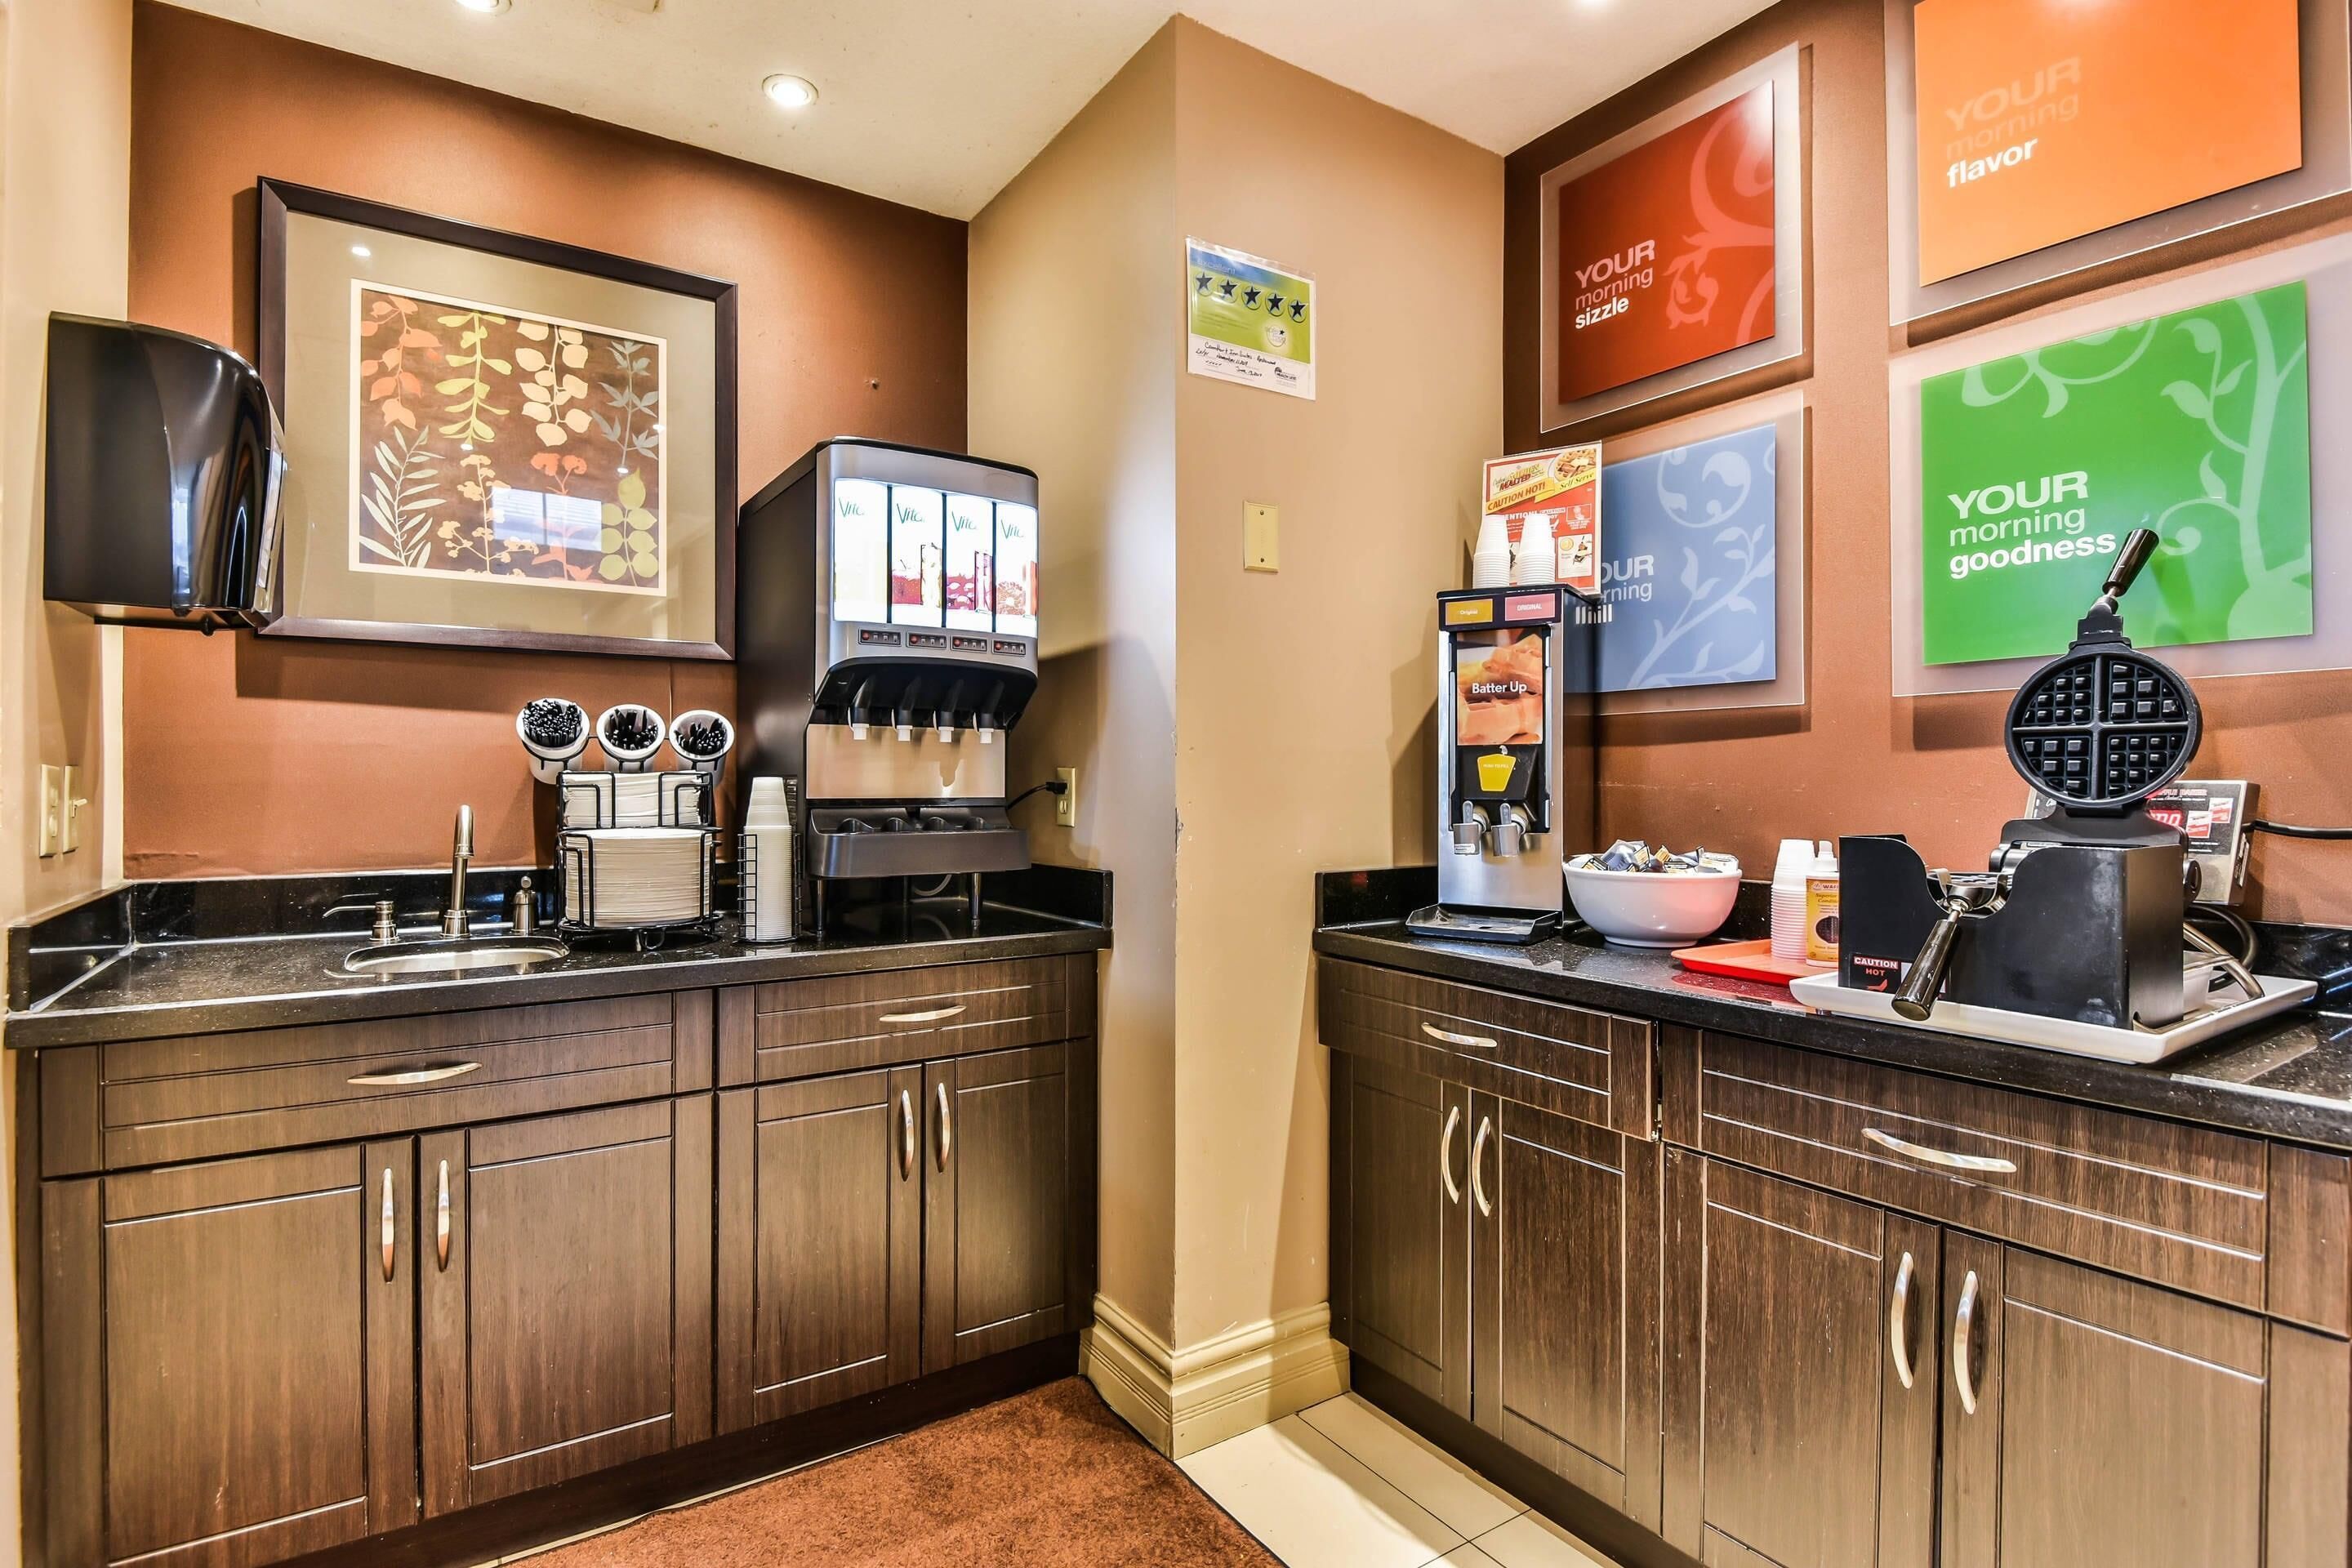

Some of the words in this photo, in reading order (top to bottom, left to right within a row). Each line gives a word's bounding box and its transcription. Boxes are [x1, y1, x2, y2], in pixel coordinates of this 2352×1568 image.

[1945, 56, 2081, 131] YOUR
[1947, 94, 2078, 160] morning
[1947, 138, 2038, 188] flavor
[1575, 239, 1655, 288] YOUR
[1575, 267, 1654, 310] morning
[1575, 296, 1629, 329] sizzle
[1488, 491, 1524, 510] CAUTION
[1525, 482, 1546, 496] HOT!
[1560, 479, 1574, 490] Self
[1575, 472, 1594, 483] Serve
[1947, 470, 2089, 519] YOUR
[1949, 508, 2085, 546] morning
[1601, 555, 1654, 584] OUR
[1949, 533, 2116, 579] goodness
[1603, 581, 1652, 603] rning
[1472, 683, 1507, 693] Batter
[1510, 681, 1527, 693] Up
[1854, 957, 1898, 969] CAUTION
[1866, 969, 1885, 977] HOT
